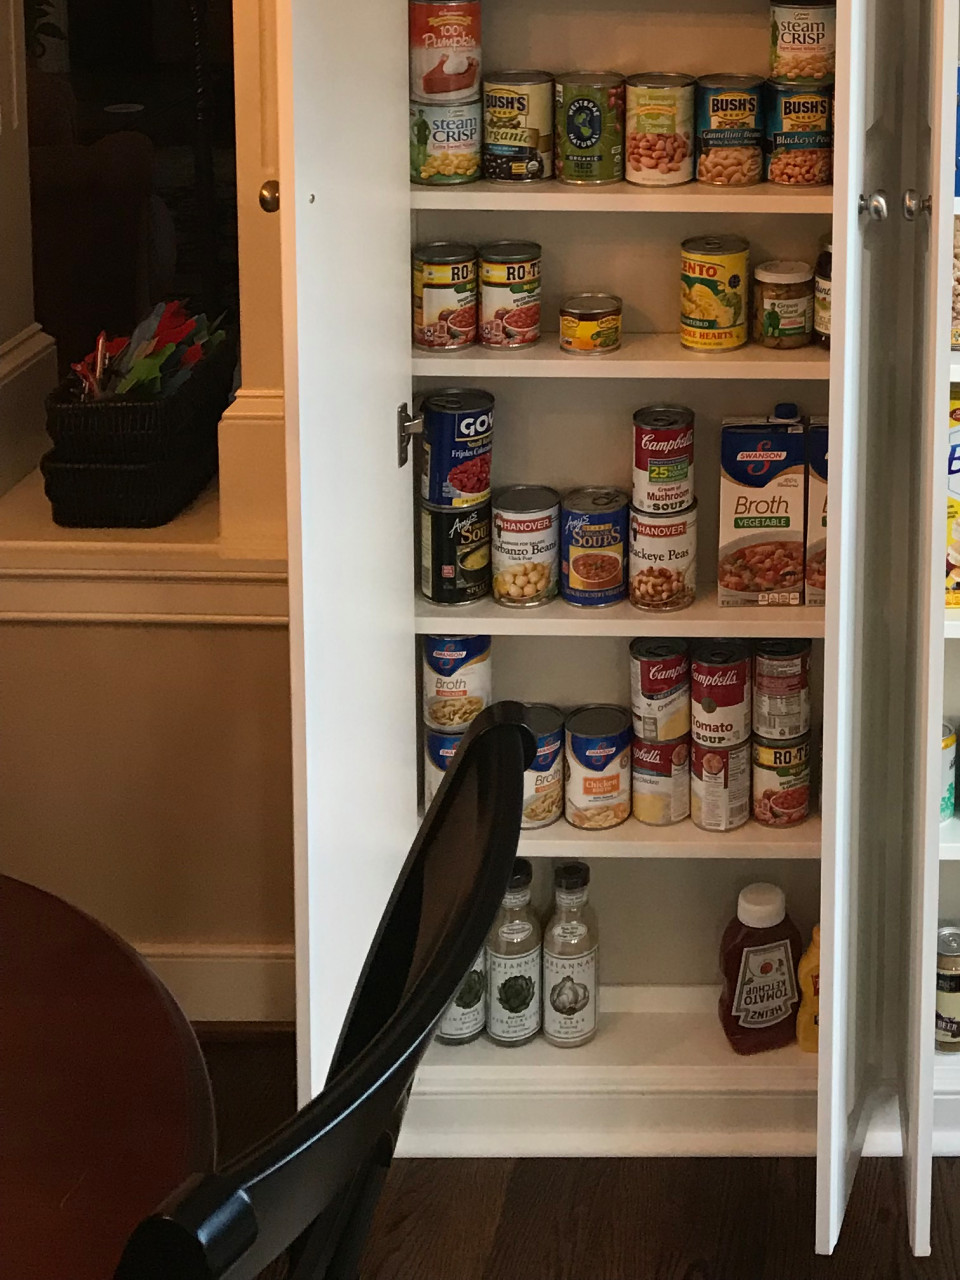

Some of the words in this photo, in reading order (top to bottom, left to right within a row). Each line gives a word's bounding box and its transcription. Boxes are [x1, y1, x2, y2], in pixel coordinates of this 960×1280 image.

[780, 20, 826, 33] steam
[422, 30, 476, 51] Pumpkin
[780, 32, 826, 44] CRISP
[486, 95, 527, 111] BUSH'S
[568, 99, 600, 118] WESTBRAE
[711, 97, 757, 113] BUSH'S
[783, 100, 828, 116] BUSH'S
[432, 117, 477, 131] steam
[432, 128, 478, 143] CRISP
[568, 133, 600, 148] NATURAL
[703, 129, 742, 139] Cannellini
[776, 134, 815, 144] Blackeye
[777, 302, 799, 310] Green
[699, 330, 734, 340] HEARTS
[739, 452, 783, 460] SWANSON
[646, 488, 690, 502] Mushroom
[652, 499, 686, 512] SOUP
[734, 494, 790, 515] Broth
[448, 510, 478, 539] Amy's
[503, 519, 551, 531] HANOVER
[738, 518, 787, 527] VEGETABLE
[460, 524, 490, 545] SOU
[571, 526, 621, 548] SOUPS
[640, 524, 685, 536] HANOVER
[493, 543, 530, 556] arbanzo
[531, 541, 557, 555] Beans
[667, 549, 690, 561] Peas
[691, 664, 738, 687] ampbell's
[435, 677, 467, 691] Broth
[695, 732, 726, 743] SOUP
[585, 779, 619, 789] Chicken
[745, 979, 787, 996] KETCHUP
[743, 988, 789, 1006] TOMATO
[750, 1005, 783, 1020] HEINZ
